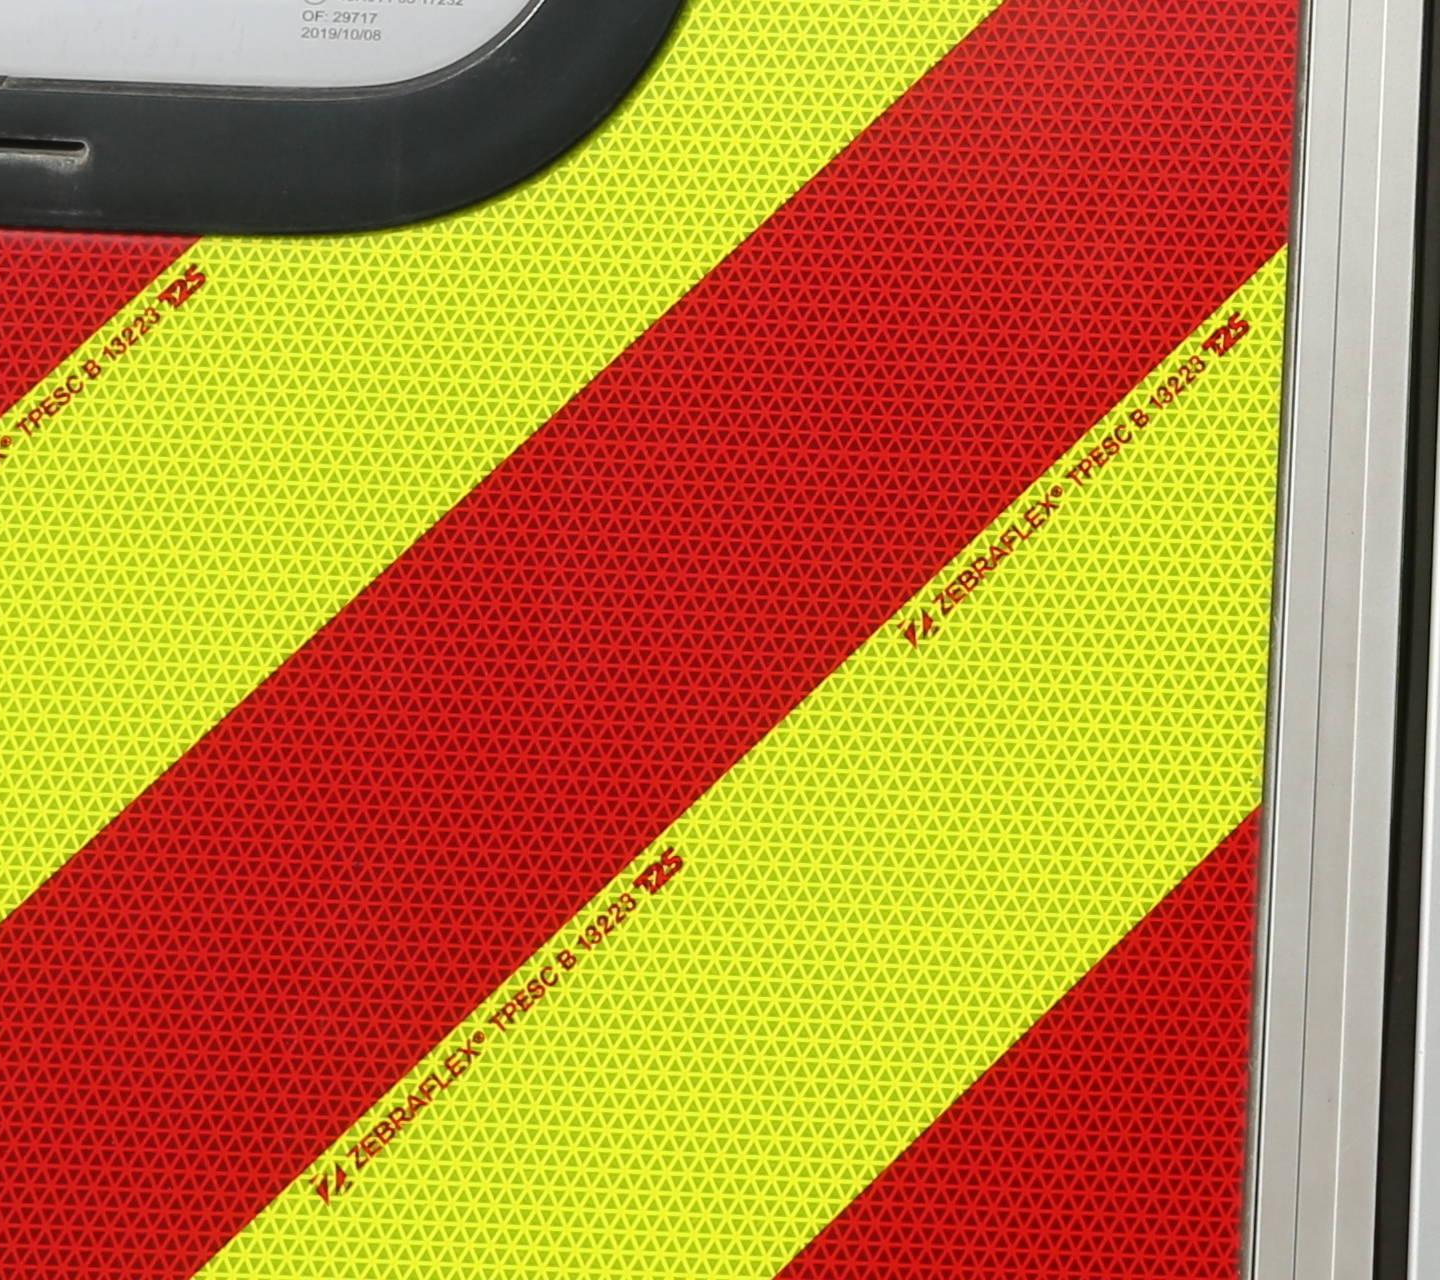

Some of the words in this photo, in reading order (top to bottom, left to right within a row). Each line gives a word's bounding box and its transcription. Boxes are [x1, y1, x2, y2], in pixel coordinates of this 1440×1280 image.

[300, 26, 382, 41] 2019/10/08
[302, 10, 328, 23] OF:
[332, 11, 378, 25] 29717
[15, 374, 85, 438] TPESC
[82, 358, 102, 379] B
[101, 305, 162, 361] 13223
[1066, 423, 1131, 487] TPESC
[1129, 407, 1151, 429] B
[1149, 353, 1206, 411] 13223
[490, 964, 559, 1032] TPESC
[556, 948, 578, 971] B
[576, 891, 638, 952] 13223
